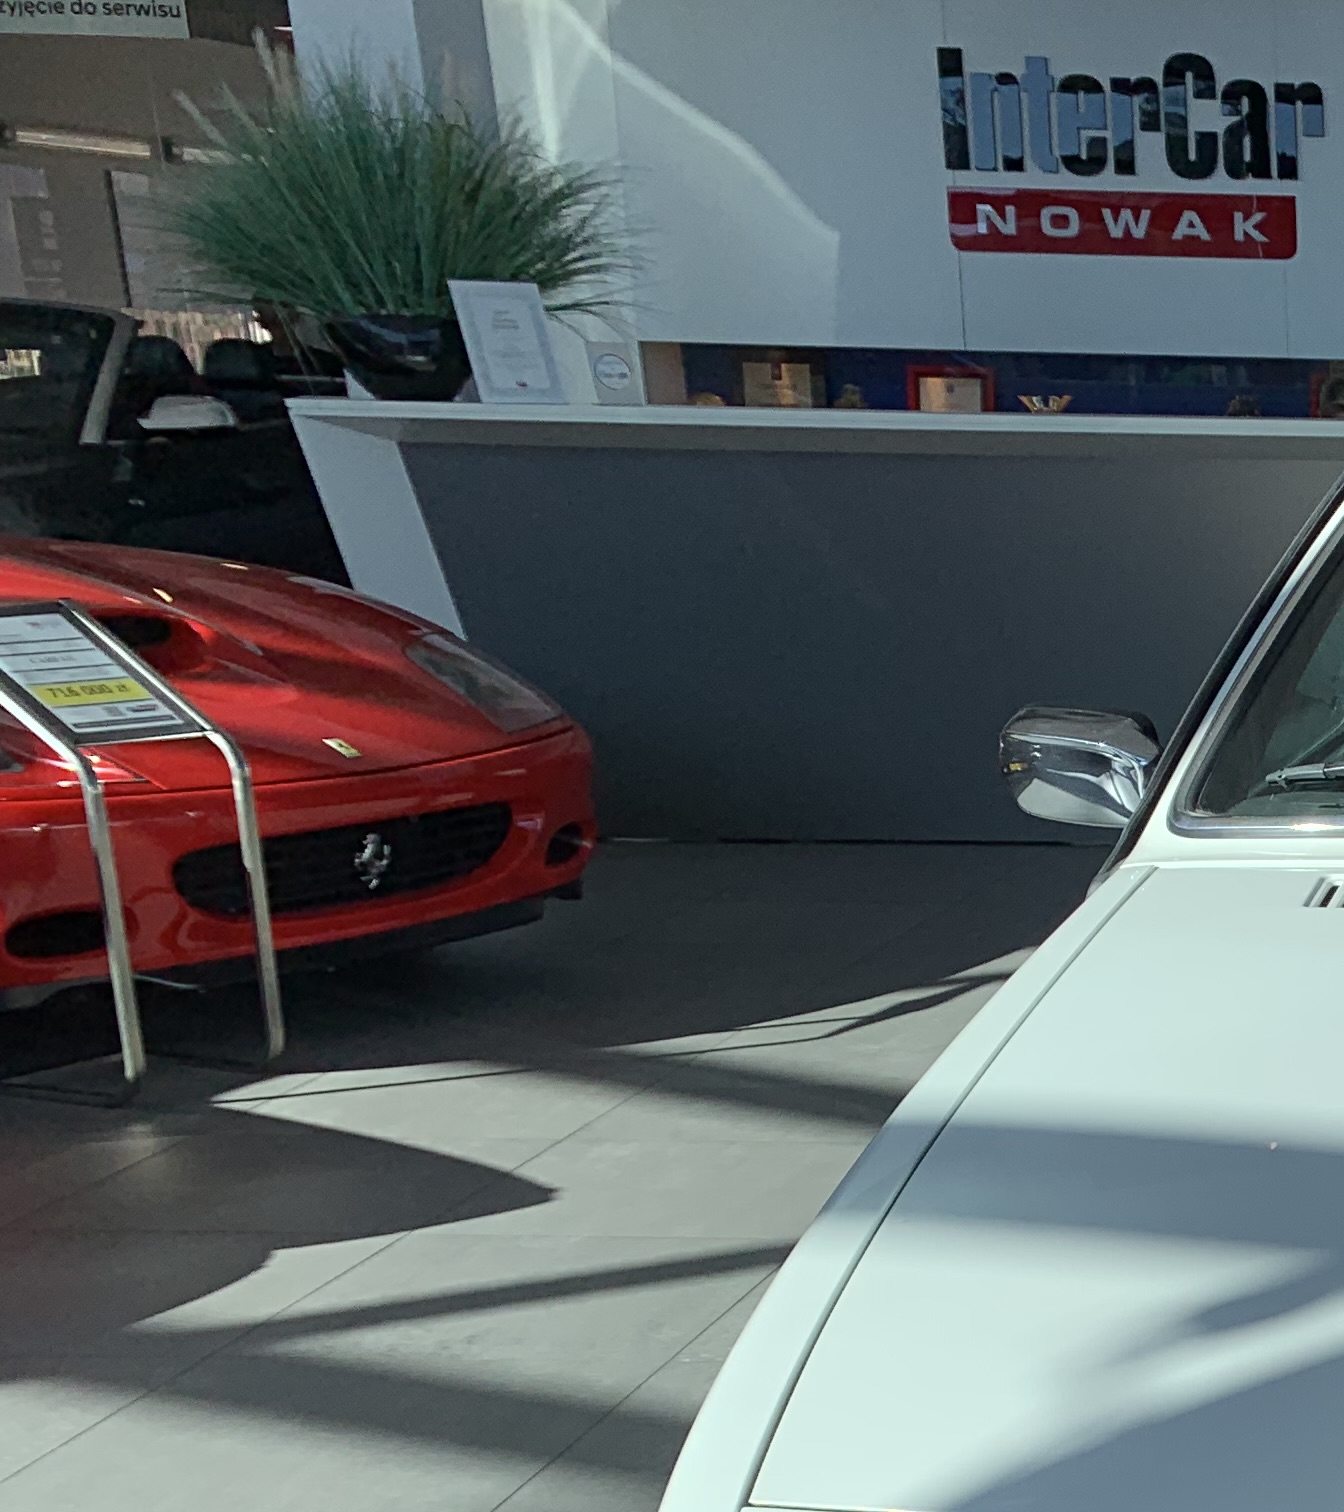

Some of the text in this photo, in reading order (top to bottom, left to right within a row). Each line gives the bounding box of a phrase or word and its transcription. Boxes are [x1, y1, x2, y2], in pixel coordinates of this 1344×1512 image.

[70, 0, 97, 15] do
[102, 1, 181, 18] serwisu
[936, 46, 1326, 181] InterCar
[975, 203, 1271, 243] NOWAK
